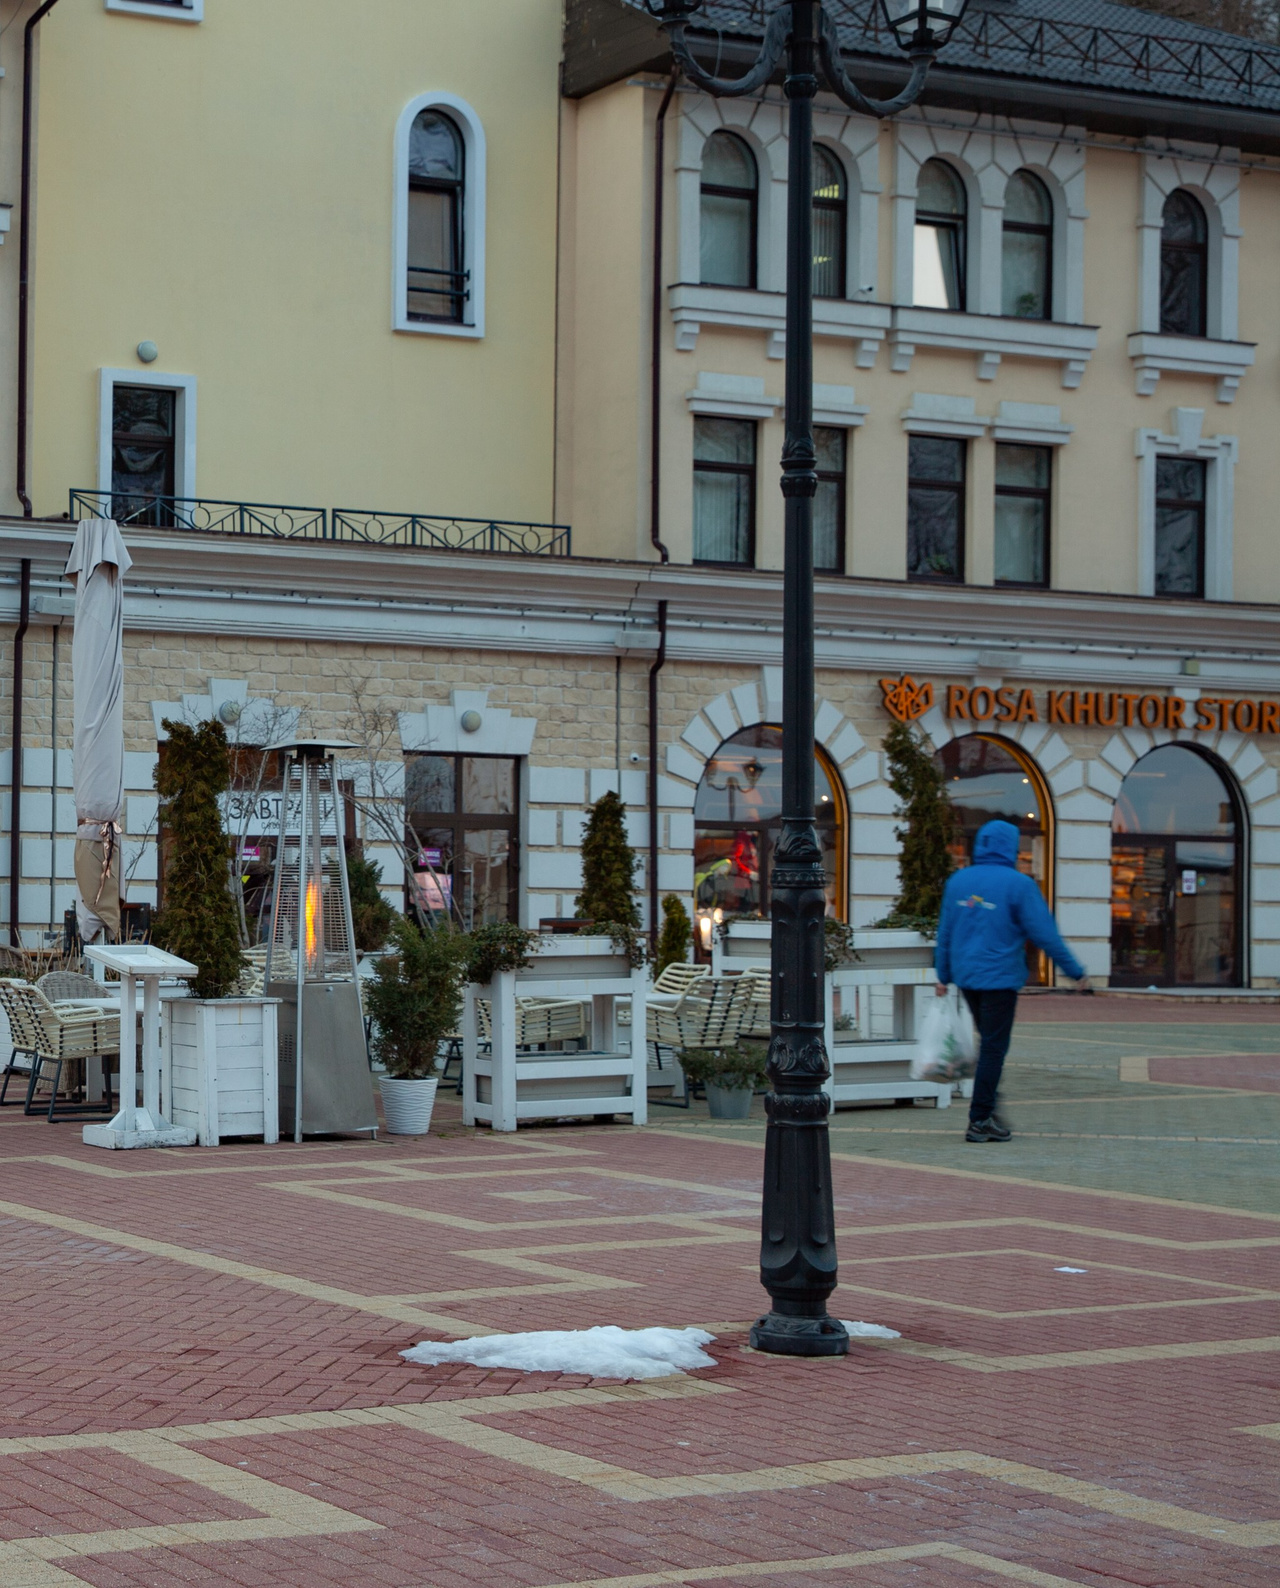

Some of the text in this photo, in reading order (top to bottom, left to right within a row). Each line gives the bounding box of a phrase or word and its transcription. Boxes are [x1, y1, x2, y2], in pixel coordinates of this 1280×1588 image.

[948, 686, 1039, 721] ROSA
[1049, 692, 1186, 729] KHUTOR
[229, 797, 337, 820] ЗАВТРАИ
